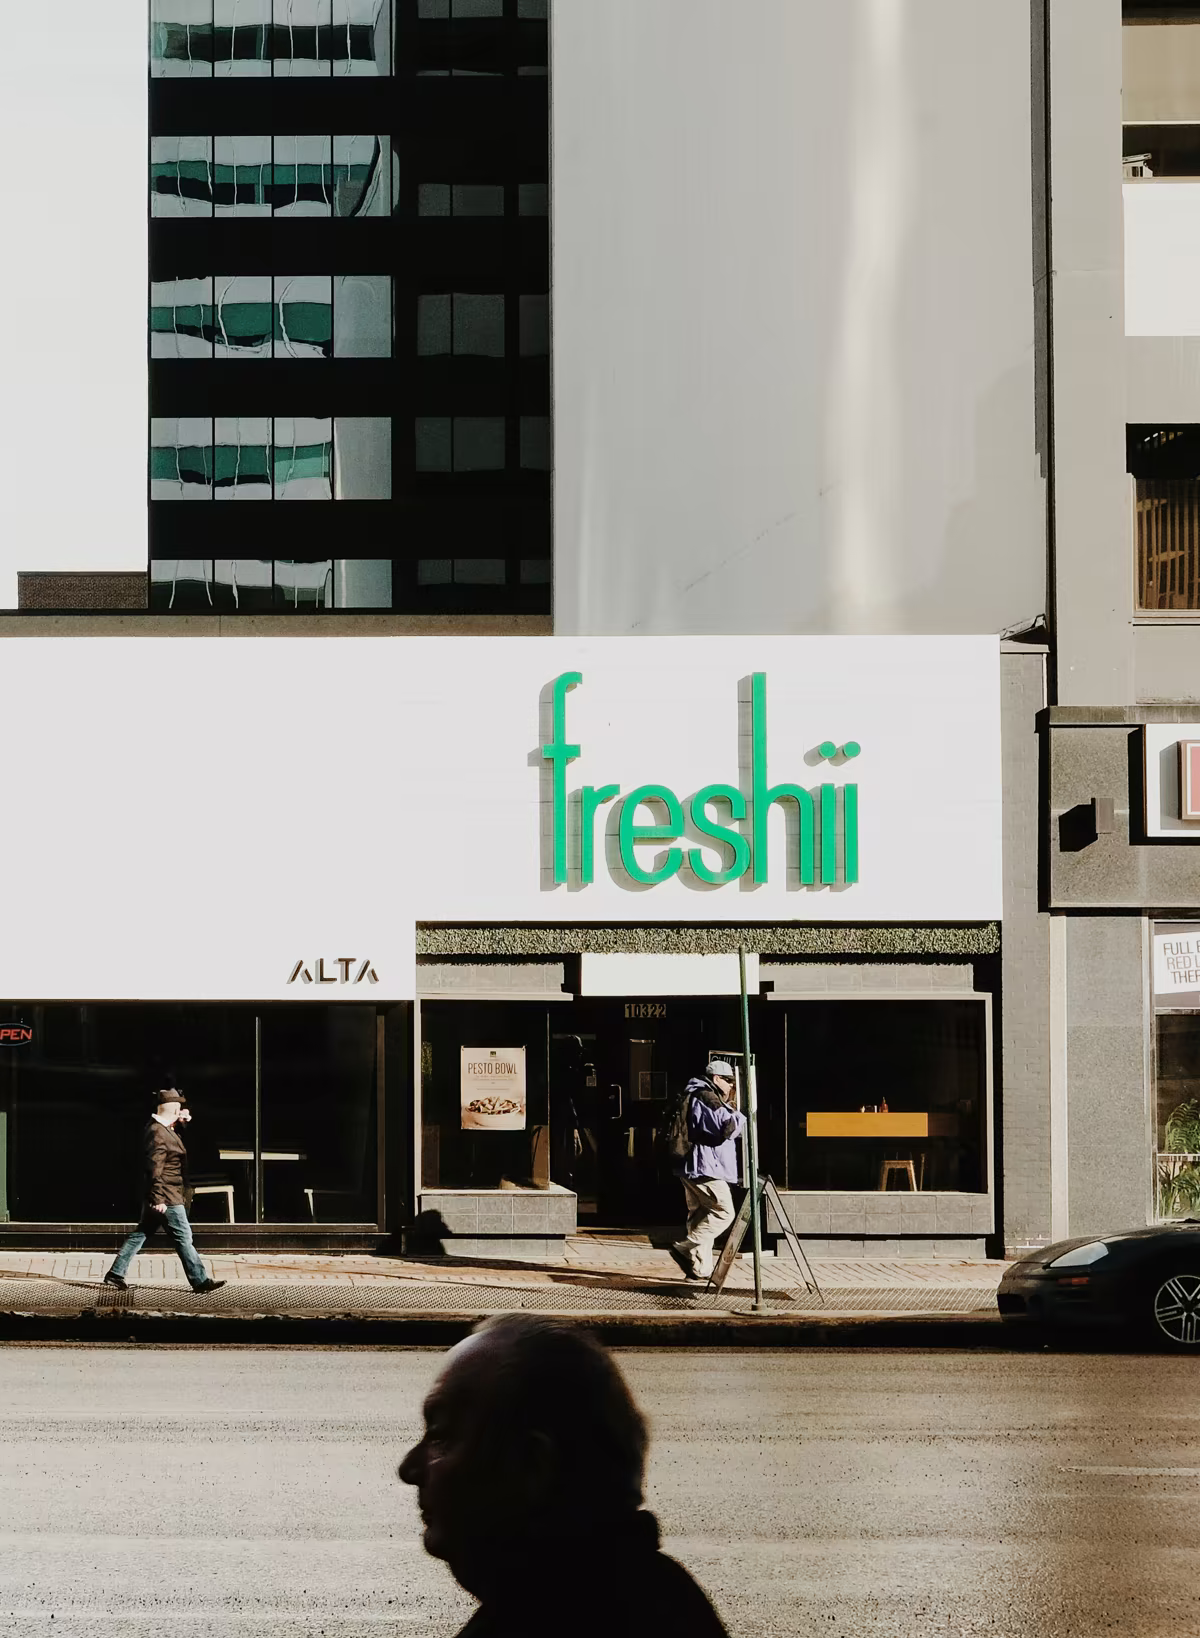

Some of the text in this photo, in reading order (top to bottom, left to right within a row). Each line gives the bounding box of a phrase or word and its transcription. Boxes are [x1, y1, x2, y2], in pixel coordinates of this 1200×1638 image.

[541, 670, 862, 886] freshii
[1163, 941, 1195, 956] FULL
[288, 957, 380, 983] ALTA
[1166, 956, 1192, 970] RED
[625, 1003, 667, 1018] 10322
[467, 1062, 518, 1075] PESTO BOWL
